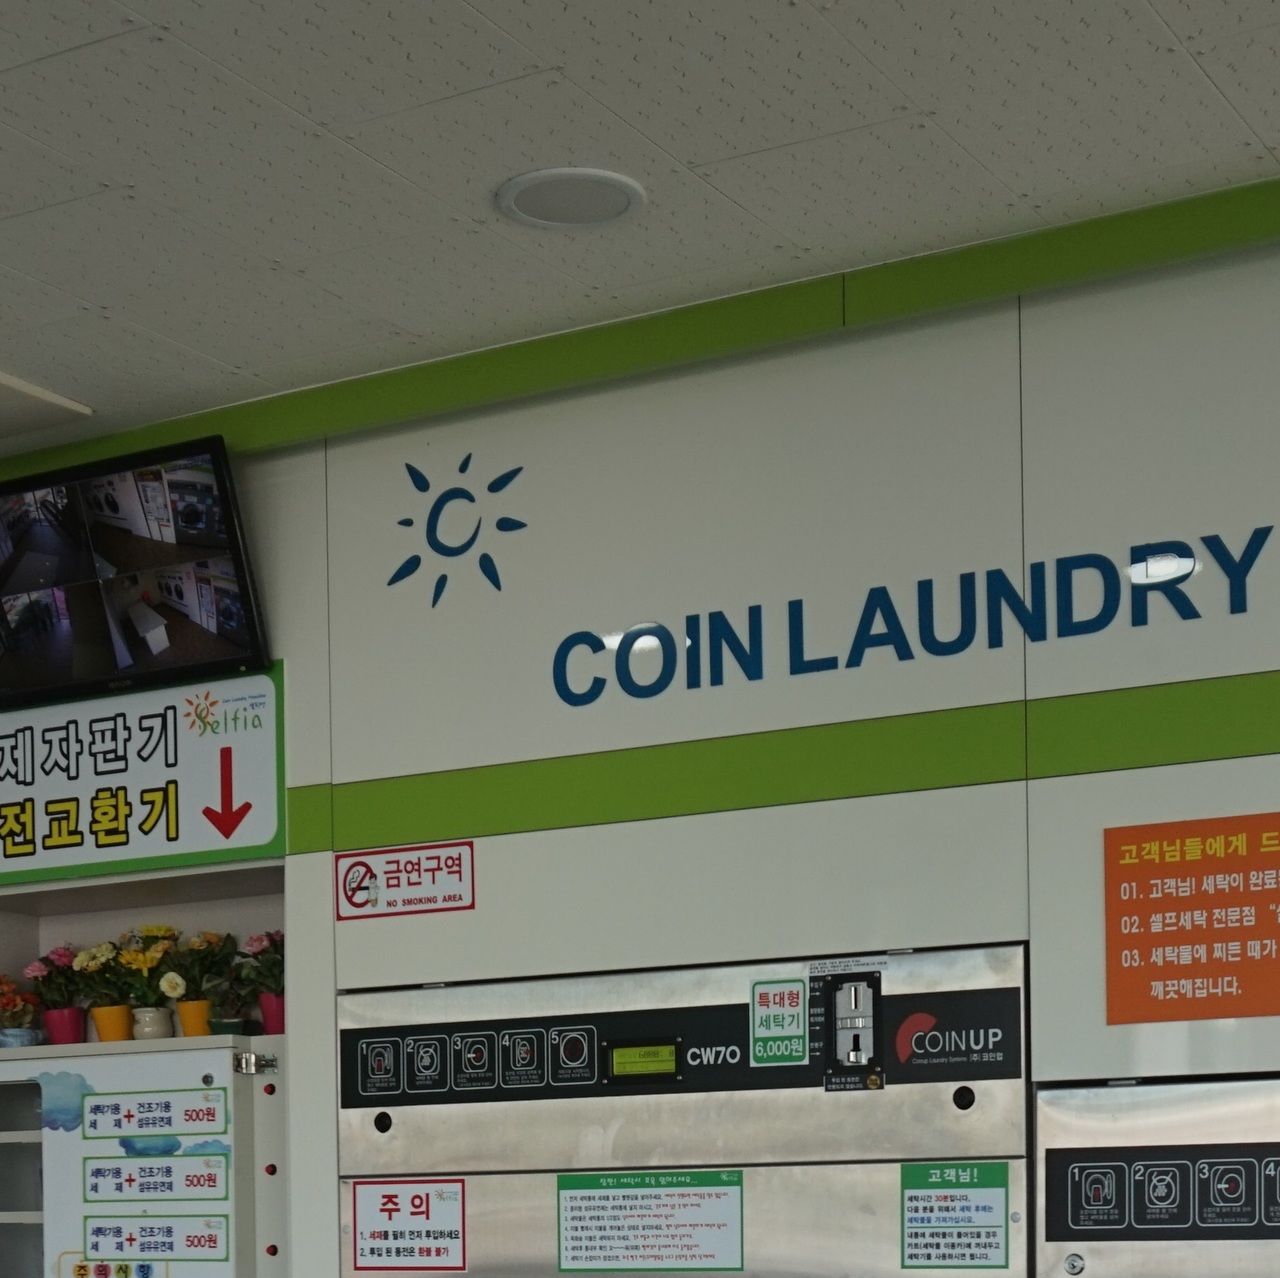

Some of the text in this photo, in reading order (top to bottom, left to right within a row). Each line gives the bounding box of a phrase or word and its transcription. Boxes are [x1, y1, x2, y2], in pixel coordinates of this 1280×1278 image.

[552, 604, 763, 707] COIN
[787, 524, 1275, 676] LAUNDRY
[1120, 833, 1247, 864] 고객님들에게
[384, 852, 462, 888] 금연구역
[1121, 883, 1143, 899] 01.
[1150, 879, 1196, 899] 고객님!
[1202, 873, 1243, 893] 세탁이
[402, 896, 438, 906] SMOKING
[442, 894, 463, 902] AREA
[1121, 917, 1143, 934] 02.
[1150, 911, 1207, 932] 셀프세탁
[1213, 906, 1255, 928] 전문점
[1122, 951, 1144, 967] 03.
[1150, 944, 1206, 966] 세탁물에
[1213, 941, 1241, 961] 찌든
[1247, 939, 1277, 960] 때가
[757, 990, 800, 1008] 특대형
[1151, 977, 1241, 1000] 깨끗해집니다.
[758, 1010, 800, 1031] 세탁기
[755, 1038, 803, 1058] 6,000원
[137, 1101, 216, 1122] 건조기용 500원
[185, 1173, 216, 1188] 500원
[928, 1168, 978, 1182] 고객님!
[185, 1234, 218, 1248] 500원
